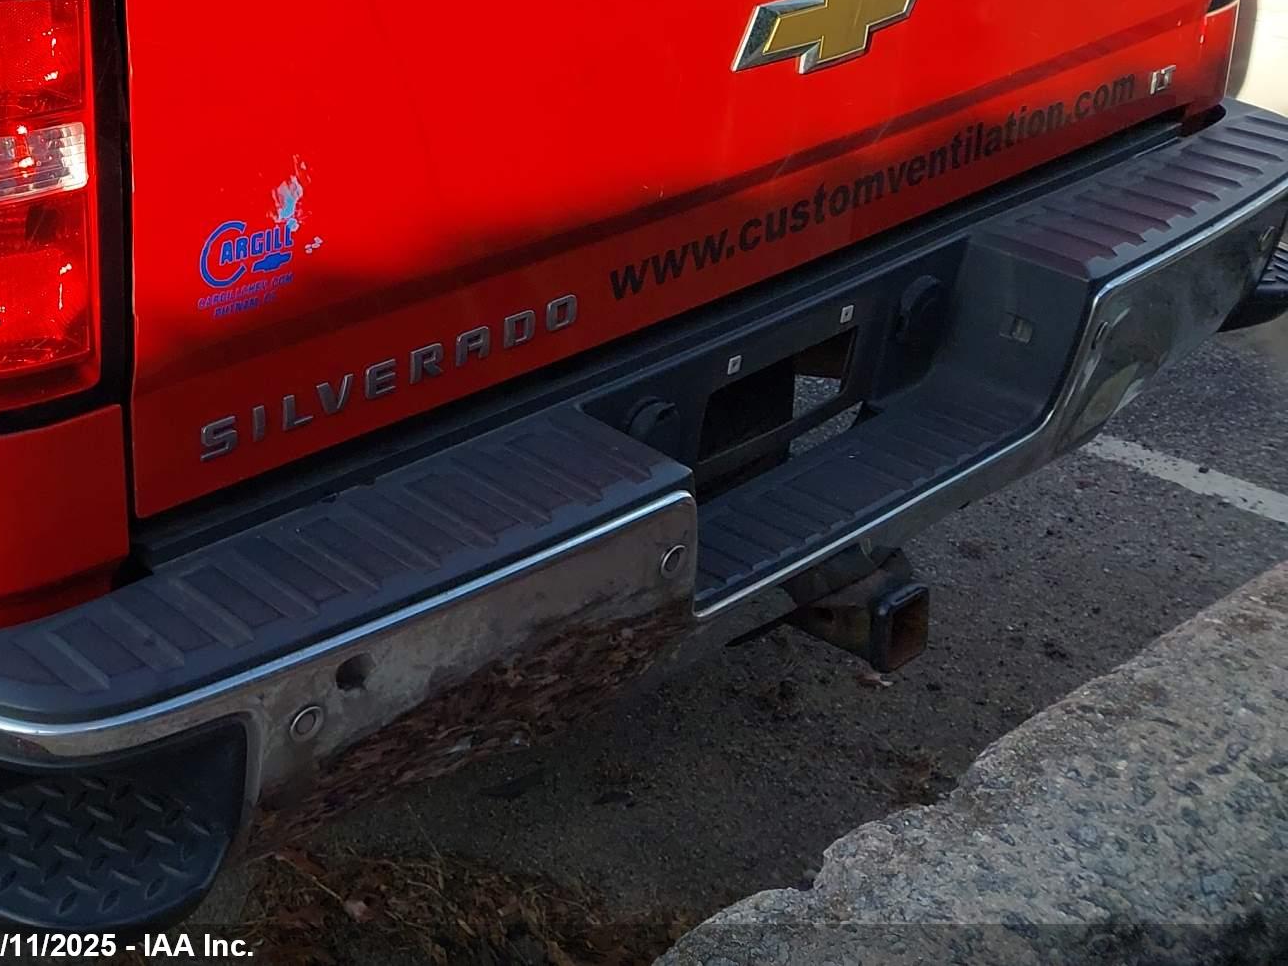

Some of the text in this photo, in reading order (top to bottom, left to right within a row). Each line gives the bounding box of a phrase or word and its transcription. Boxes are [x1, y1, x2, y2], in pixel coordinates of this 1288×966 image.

[1149, 64, 1177, 95] LT
[609, 68, 1135, 302] www.customventilation.com
[199, 220, 295, 288] CARGILL
[200, 294, 578, 462] SILVERADO
